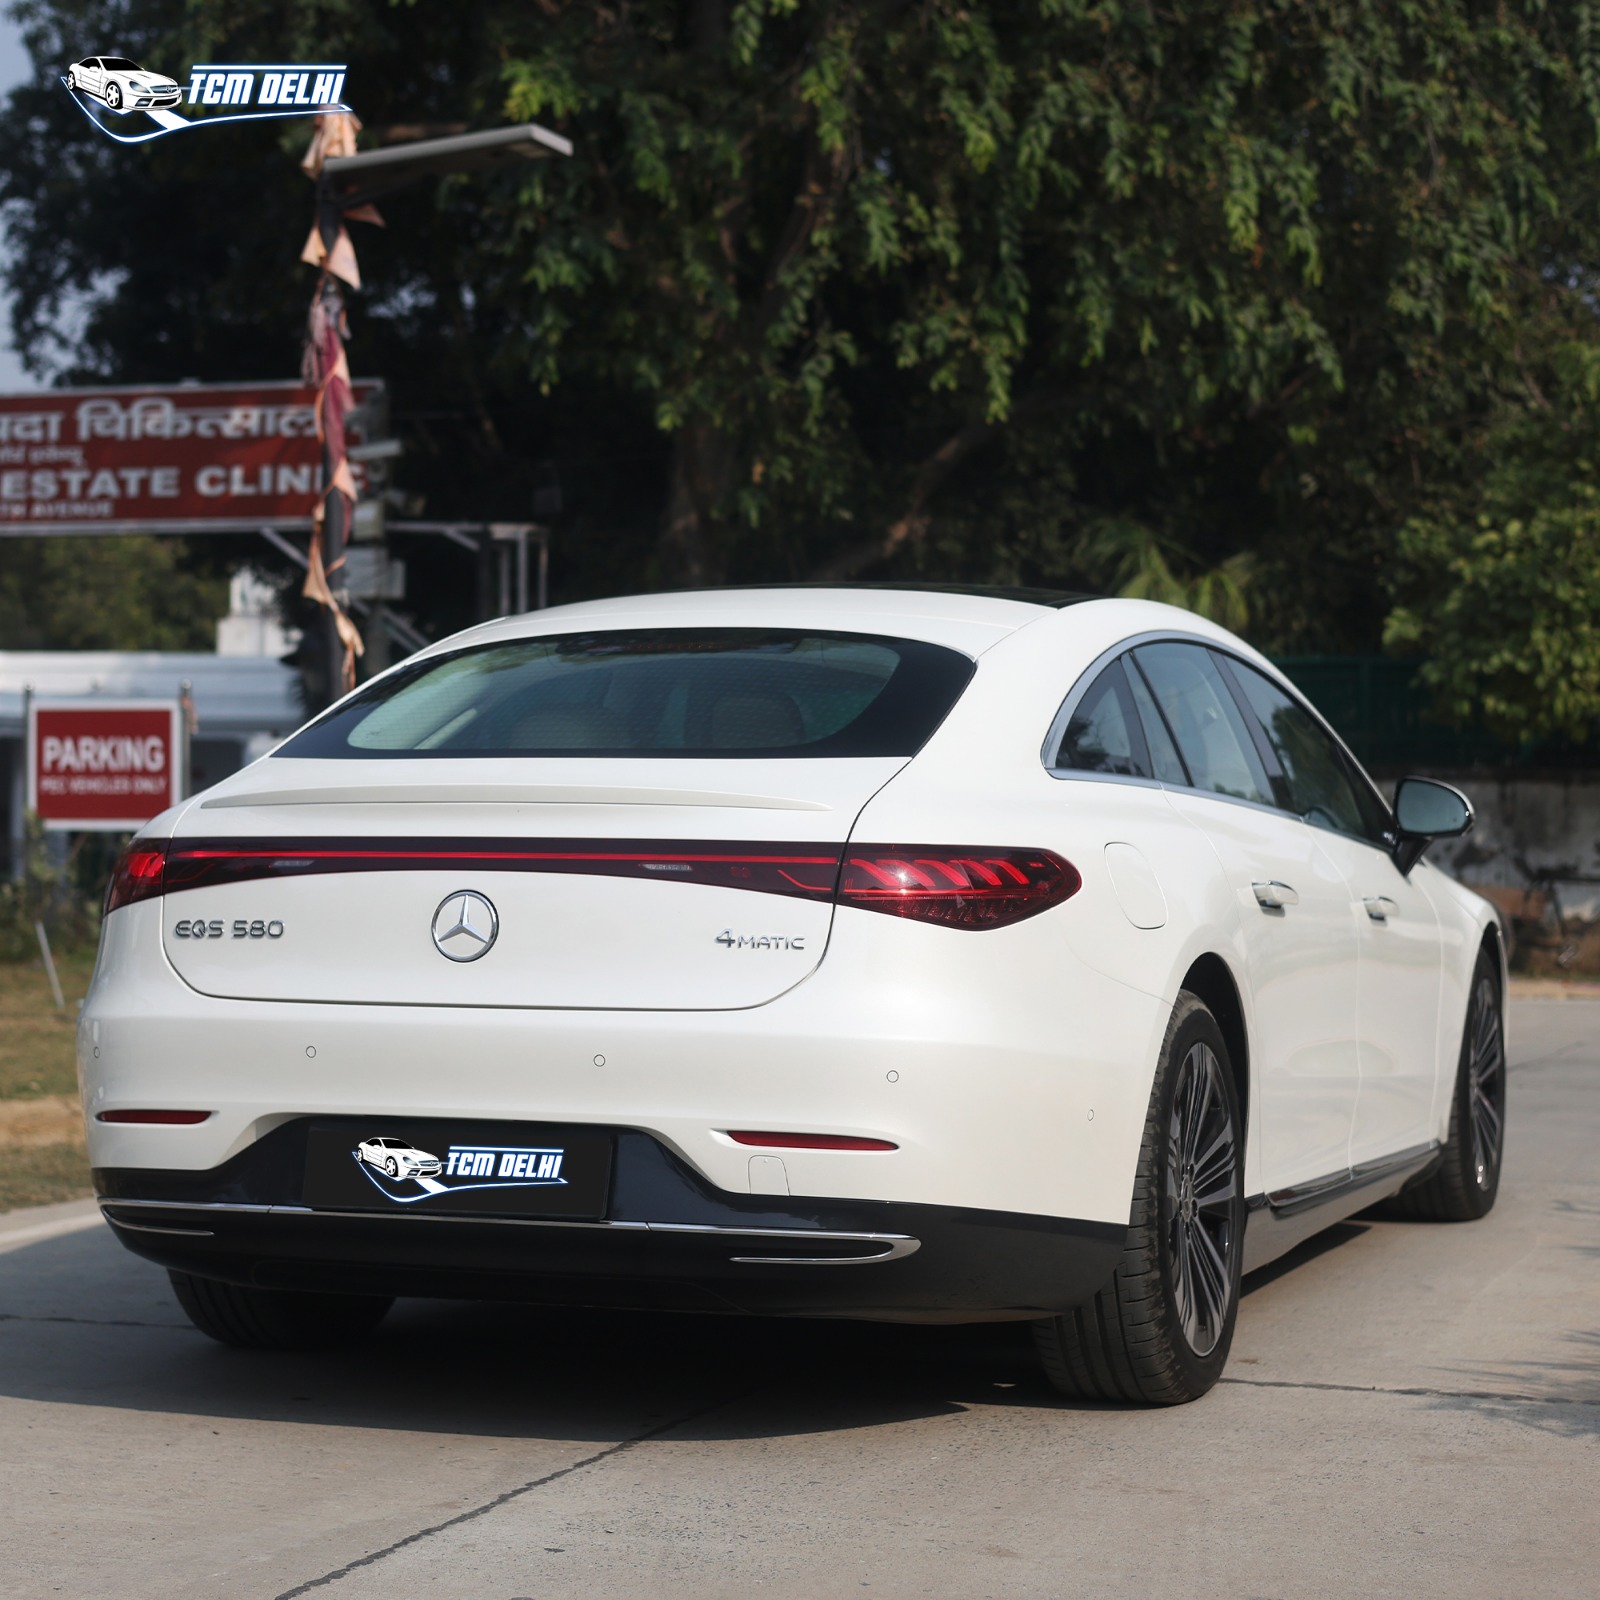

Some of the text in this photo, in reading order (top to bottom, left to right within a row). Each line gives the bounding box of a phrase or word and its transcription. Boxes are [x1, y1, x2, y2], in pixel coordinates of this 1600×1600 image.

[75, 396, 319, 441] चिकित्साल
[2, 466, 181, 499] ESTATE
[31, 500, 113, 517] AVENUE
[42, 735, 165, 772] PARKING
[132, 775, 167, 794] ONLY
[175, 919, 285, 938] EQS 580
[714, 928, 805, 950] 4MATIC
